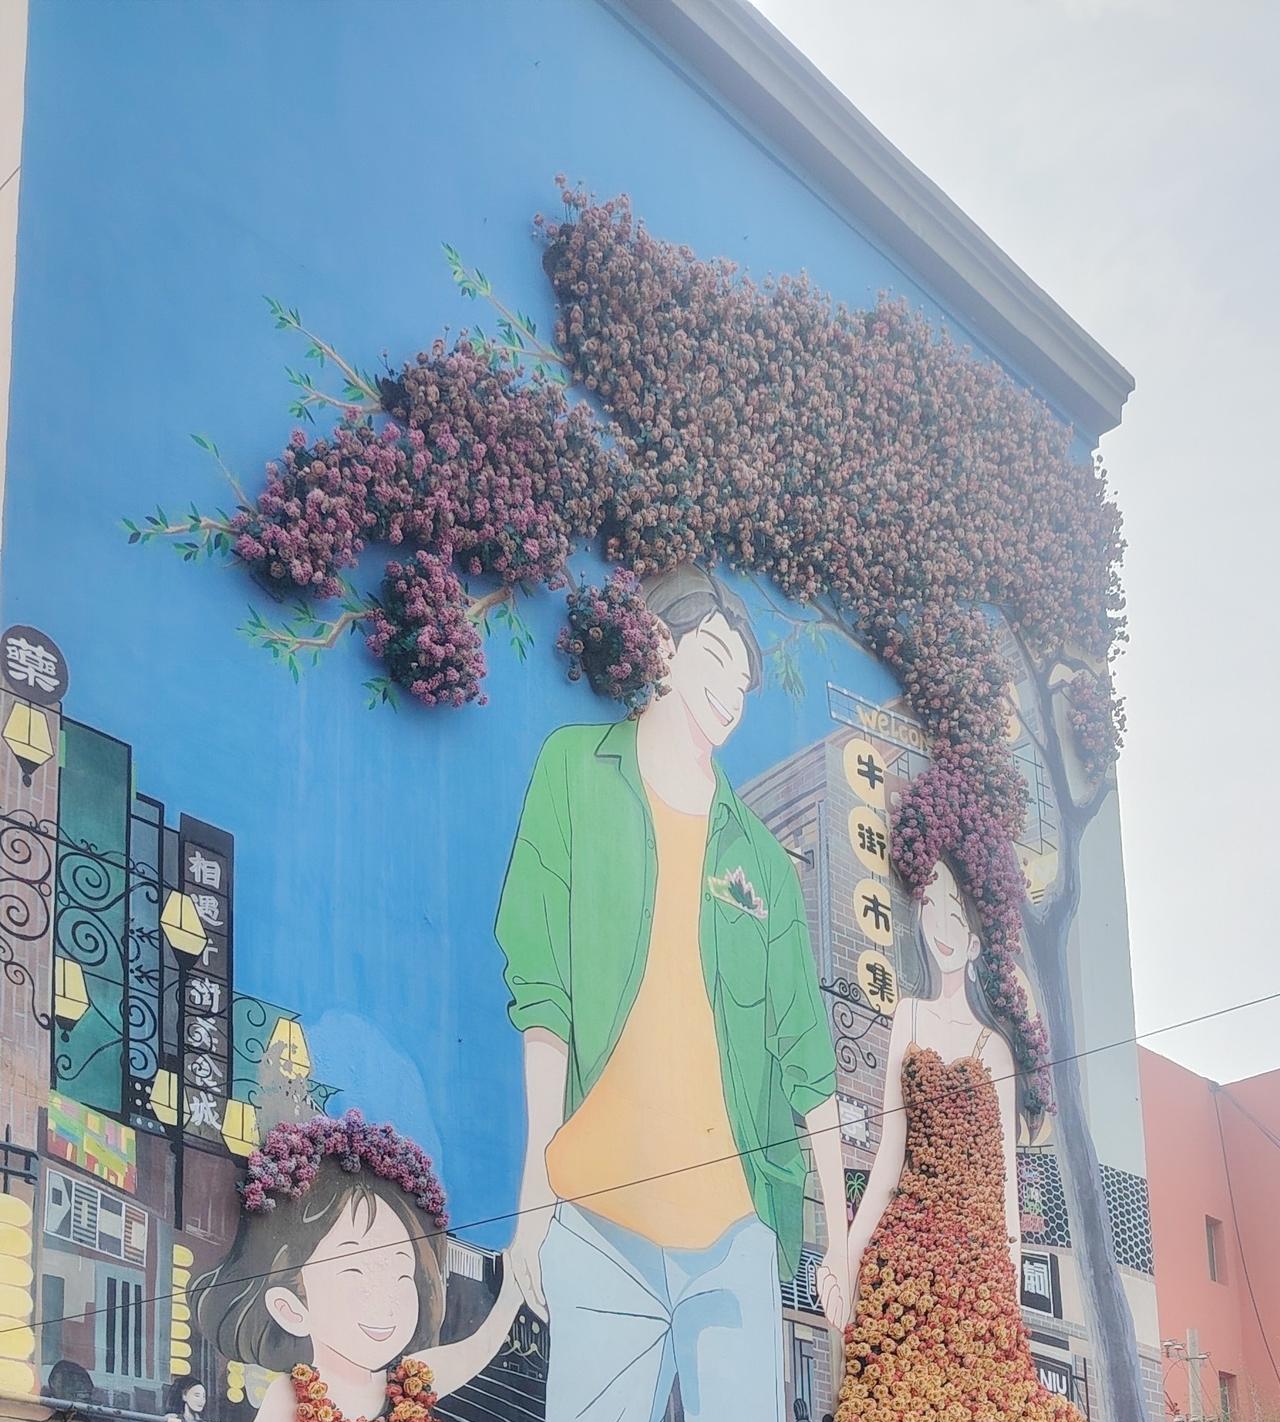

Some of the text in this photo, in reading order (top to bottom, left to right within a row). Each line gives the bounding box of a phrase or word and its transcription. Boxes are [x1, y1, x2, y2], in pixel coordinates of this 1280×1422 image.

[6, 637, 61, 693] 藥
[857, 753, 895, 1004] 牛街市集
[1039, 1368, 1067, 1395] NIU
